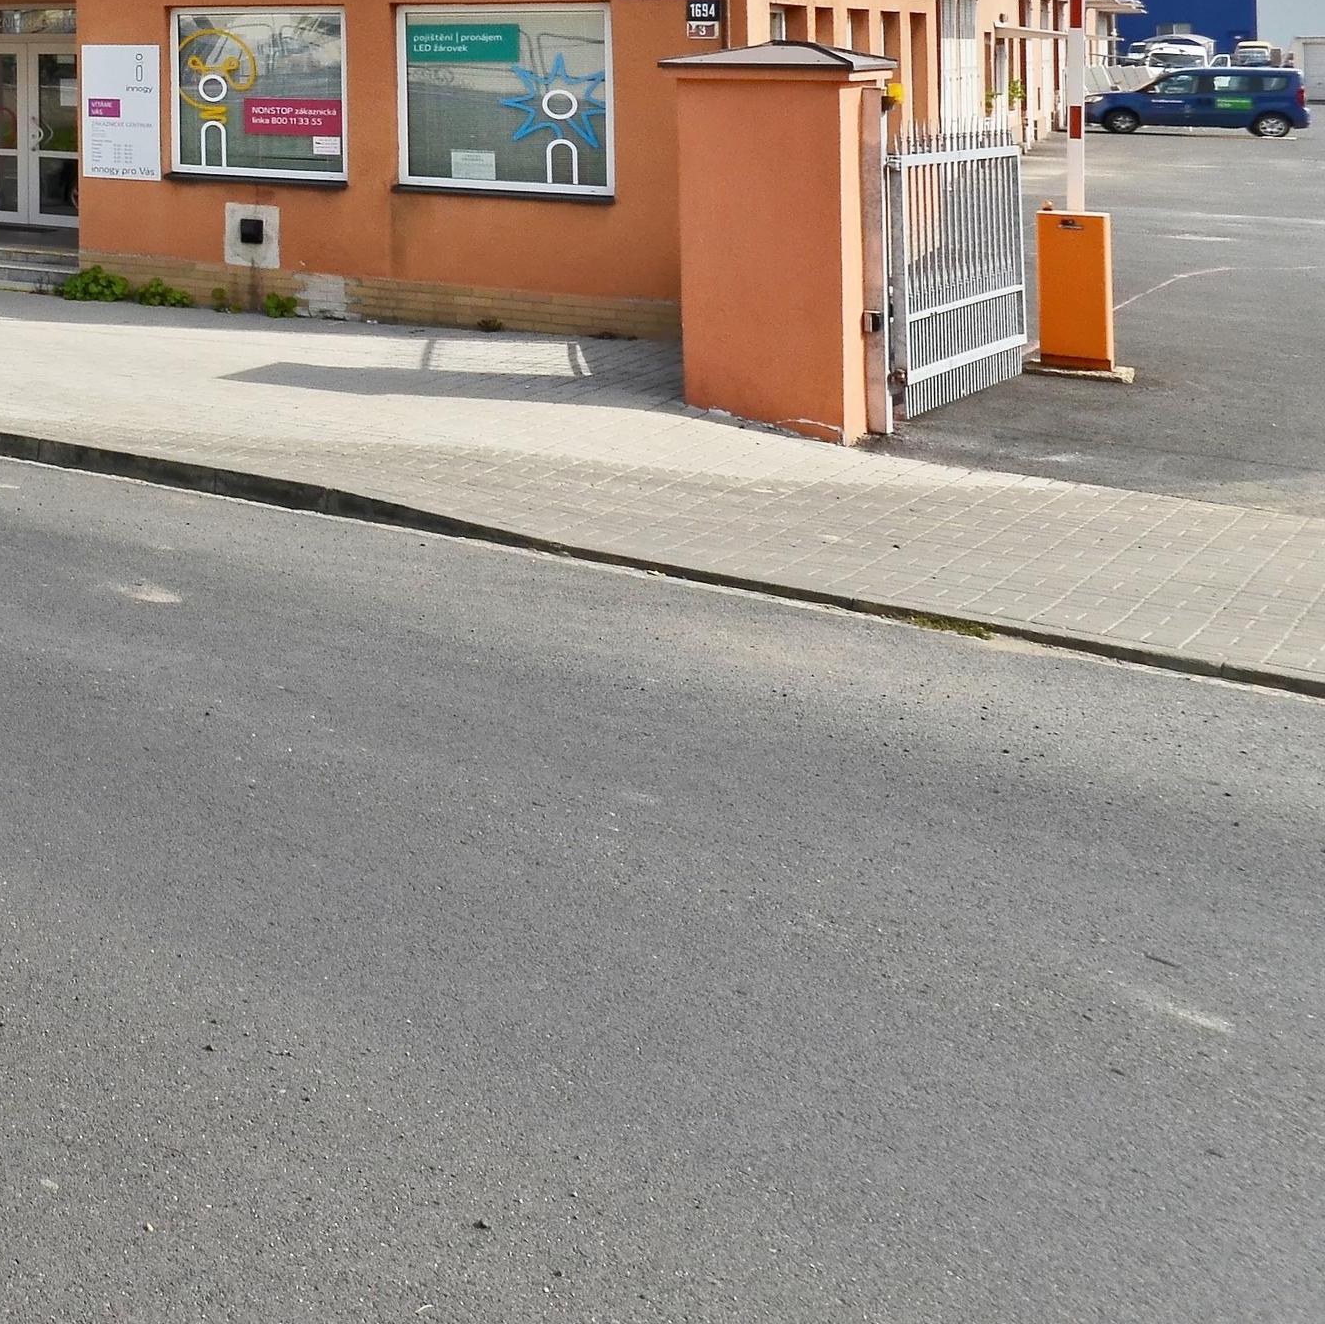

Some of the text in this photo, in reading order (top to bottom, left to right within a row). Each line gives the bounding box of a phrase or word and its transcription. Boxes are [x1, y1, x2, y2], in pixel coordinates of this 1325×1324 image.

[689, 2, 716, 18] 1694
[460, 33, 503, 43] pronájem
[413, 43, 469, 53] LED žárovek
[125, 85, 153, 94] innogy
[251, 106, 294, 115] NONSTOP
[251, 116, 323, 126] linka 800 11 33 55
[91, 166, 119, 176] innogy
[121, 167, 137, 176] pro
